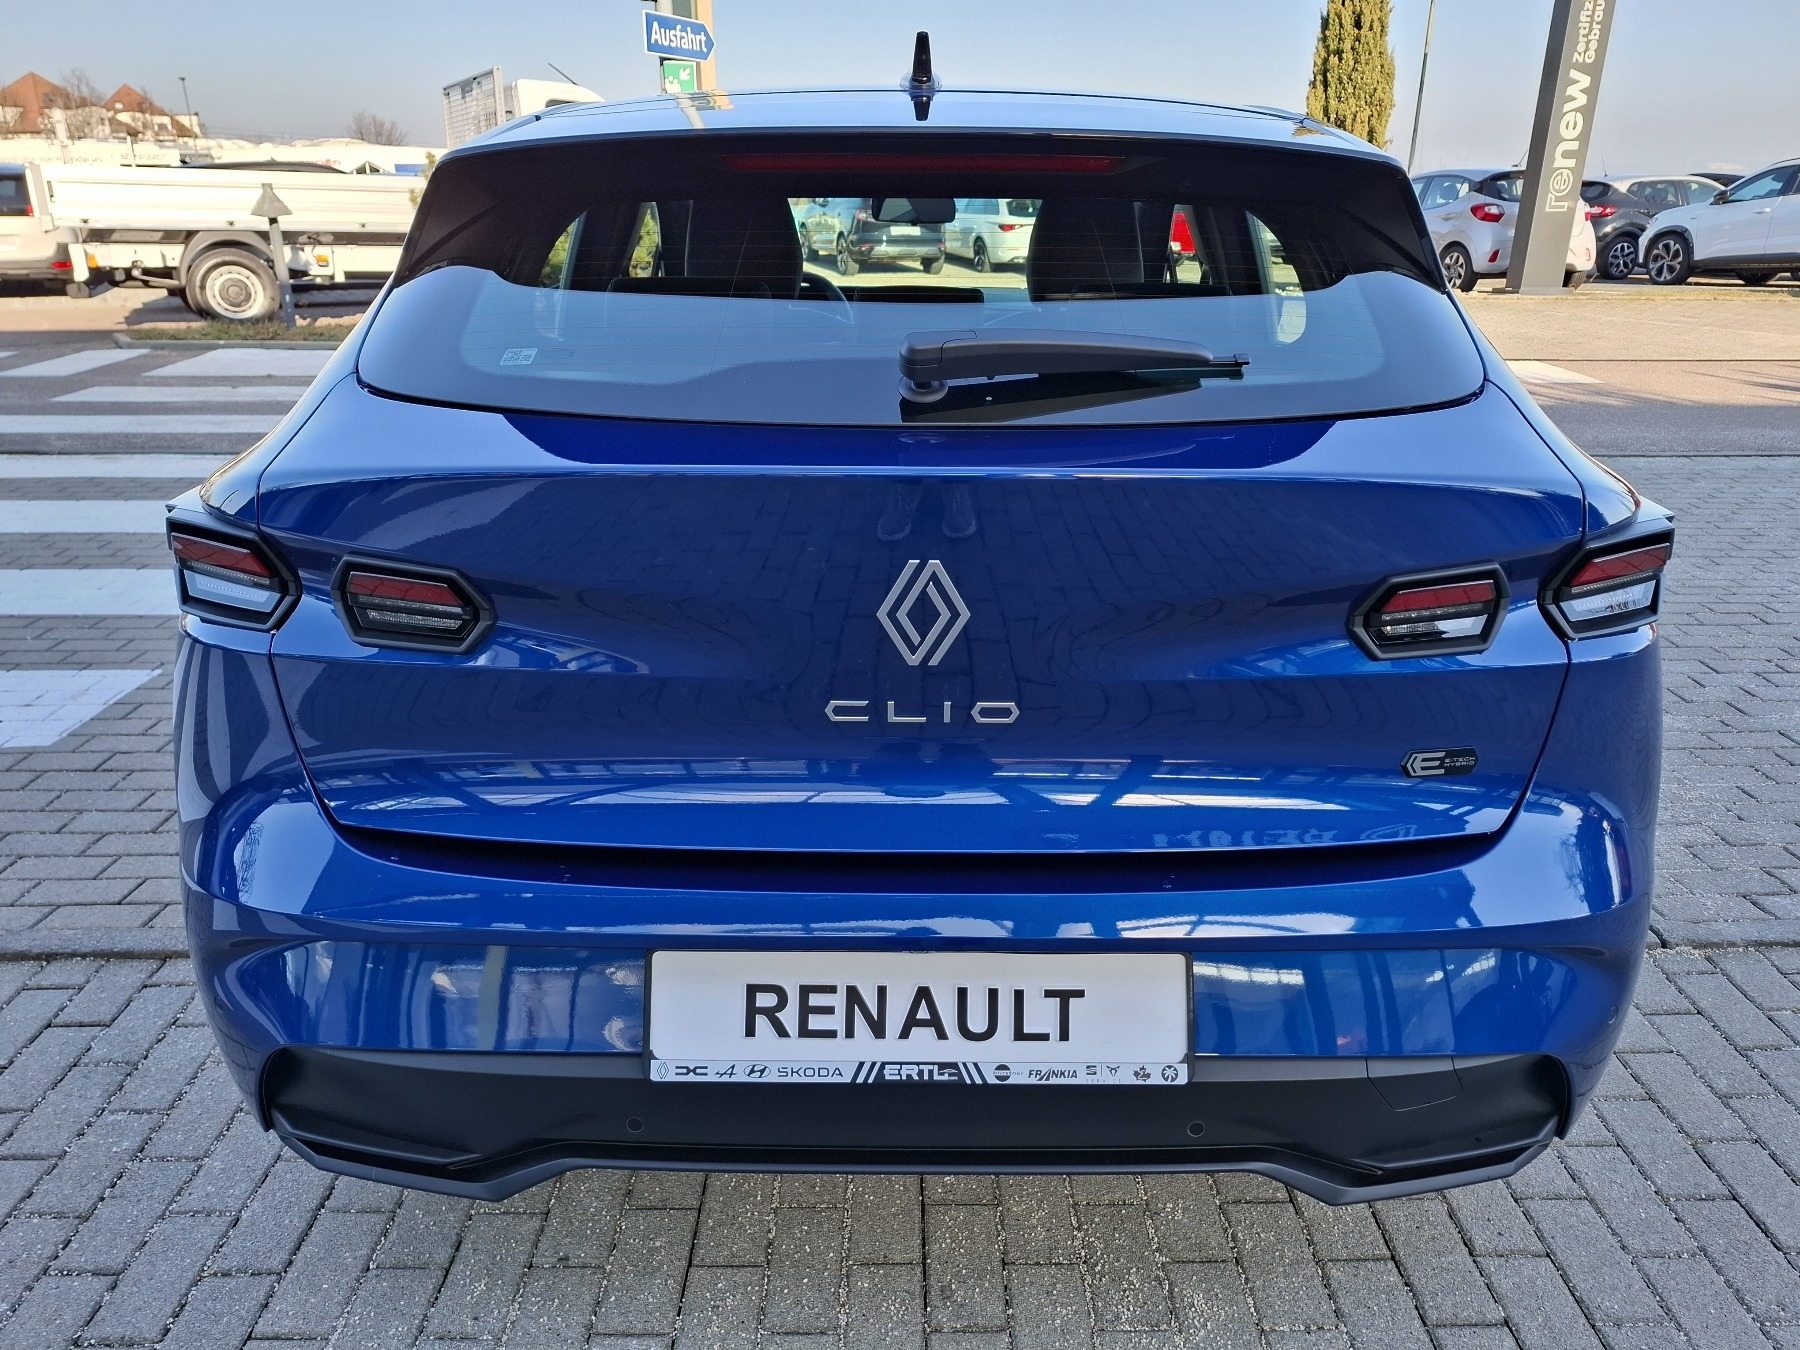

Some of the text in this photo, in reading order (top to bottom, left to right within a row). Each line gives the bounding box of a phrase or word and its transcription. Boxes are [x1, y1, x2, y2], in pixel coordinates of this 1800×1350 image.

[650, 20, 708, 53] Ausfahrt
[1544, 68, 1592, 212] renew
[824, 700, 1020, 724] CLIO
[744, 982, 1086, 1042] RENAULT
[883, 1064, 949, 1081] ERTL
[1028, 1066, 1079, 1082] FRANKIA
